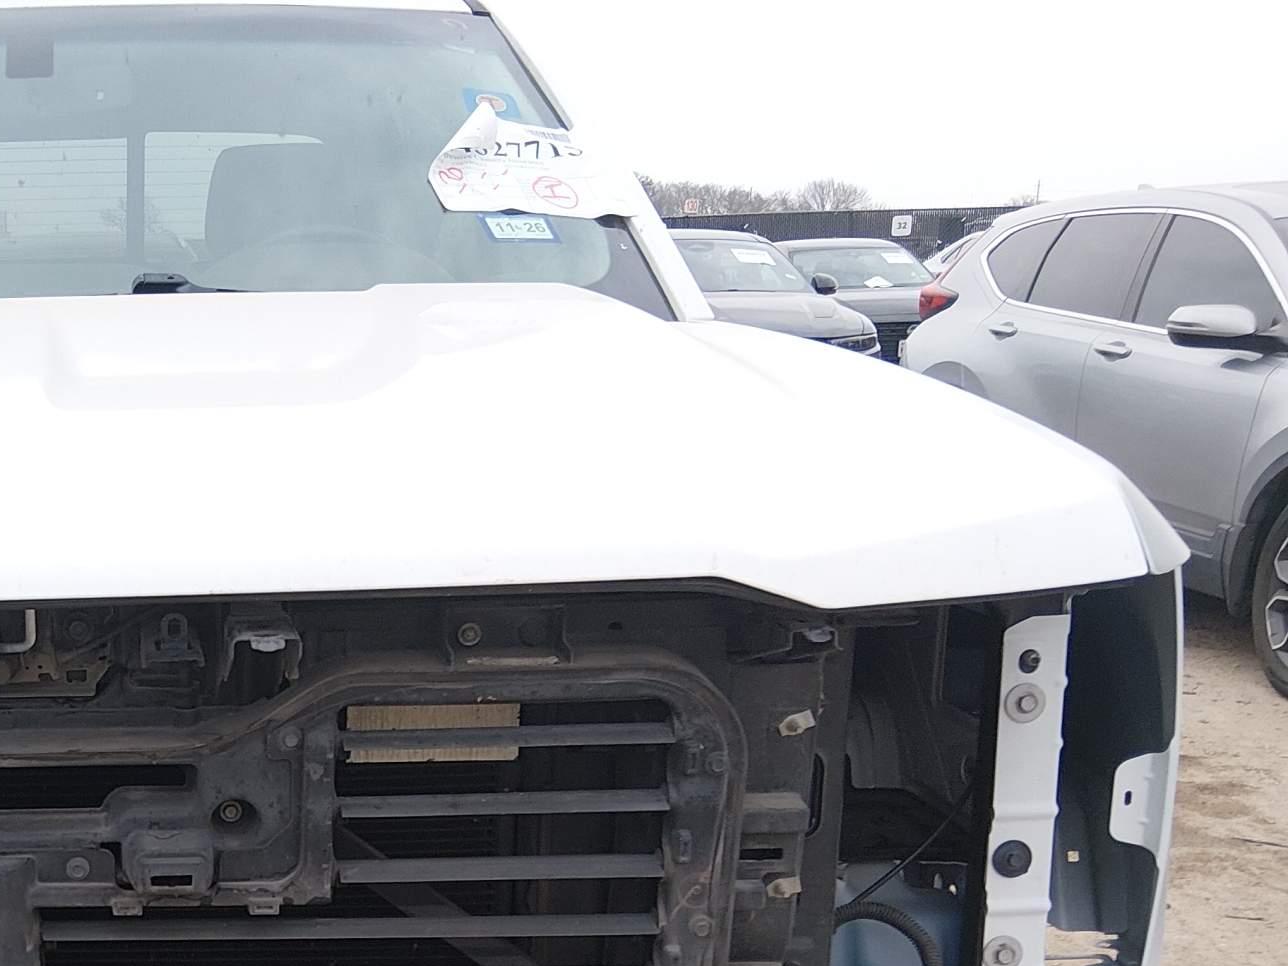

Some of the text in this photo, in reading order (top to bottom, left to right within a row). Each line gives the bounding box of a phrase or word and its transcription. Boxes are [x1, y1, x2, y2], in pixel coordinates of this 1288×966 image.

[495, 221, 547, 233] 11 26
[896, 221, 908, 231] 32
